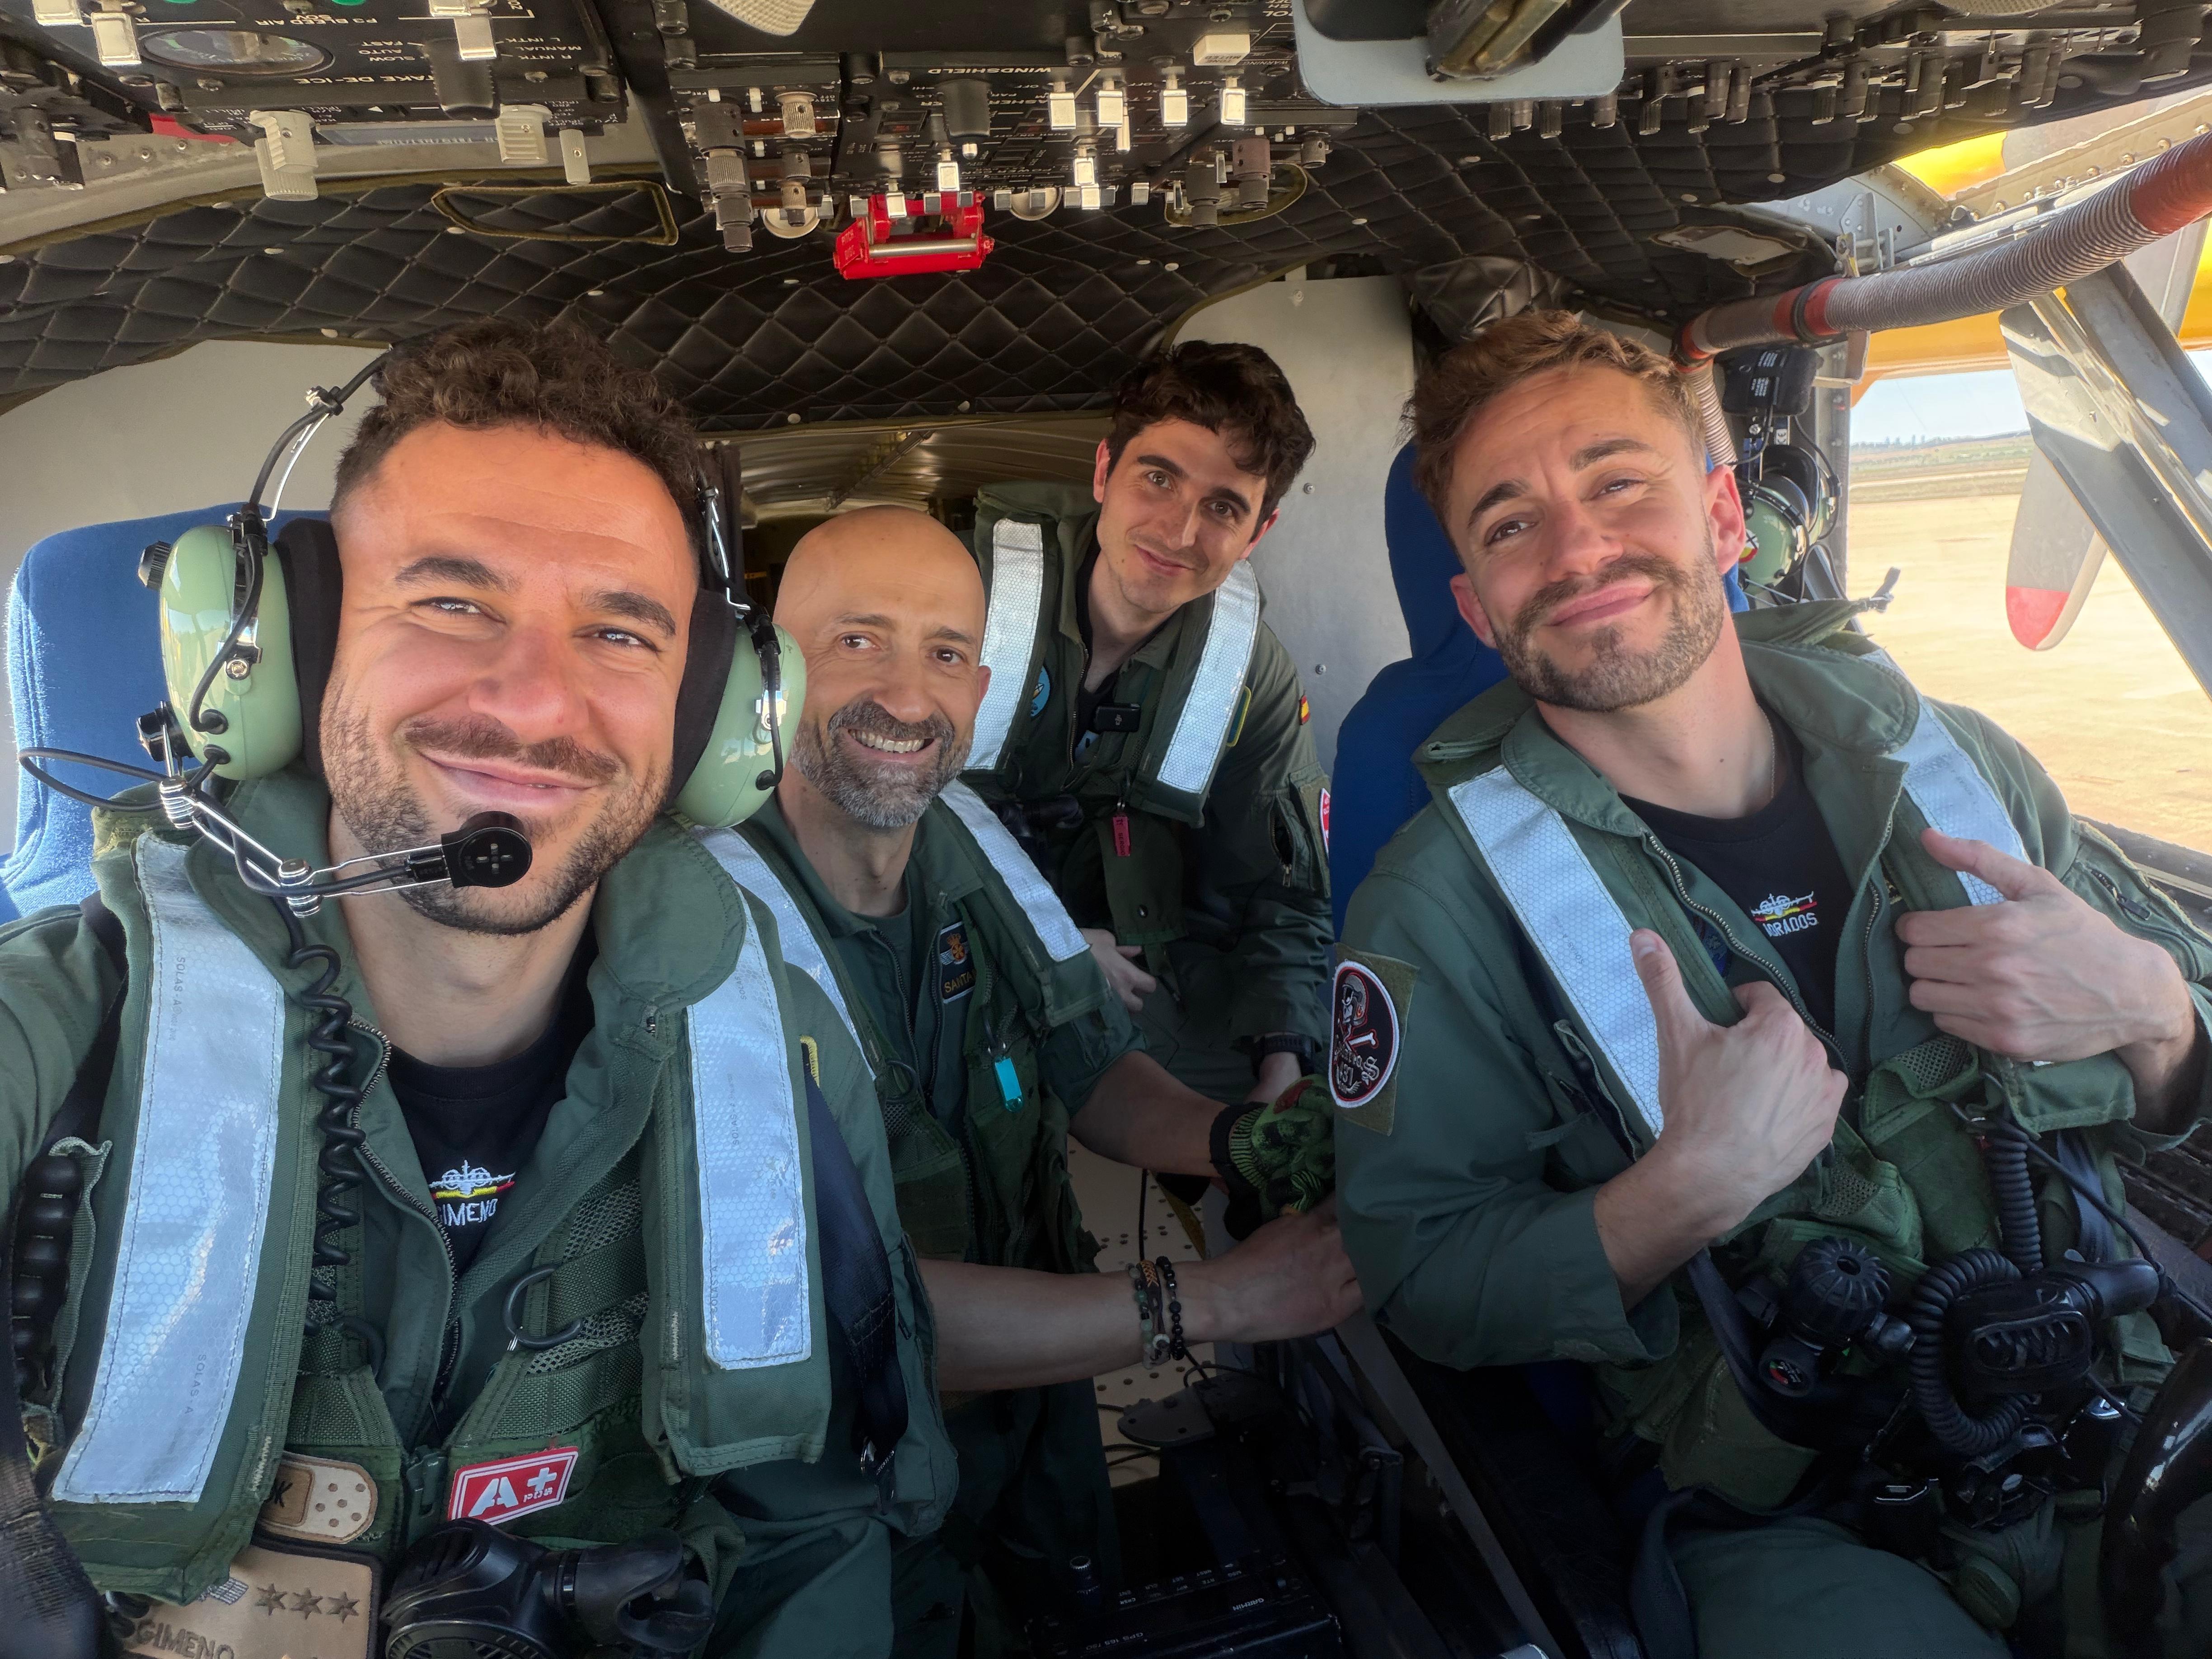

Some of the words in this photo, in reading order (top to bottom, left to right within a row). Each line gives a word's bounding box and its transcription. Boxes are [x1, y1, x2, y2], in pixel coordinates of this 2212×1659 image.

[1233, 1597, 1264, 1612] GARMIN
[135, 1619, 234, 1659] GIMENO
[1122, 1632, 1143, 1641] GPS
